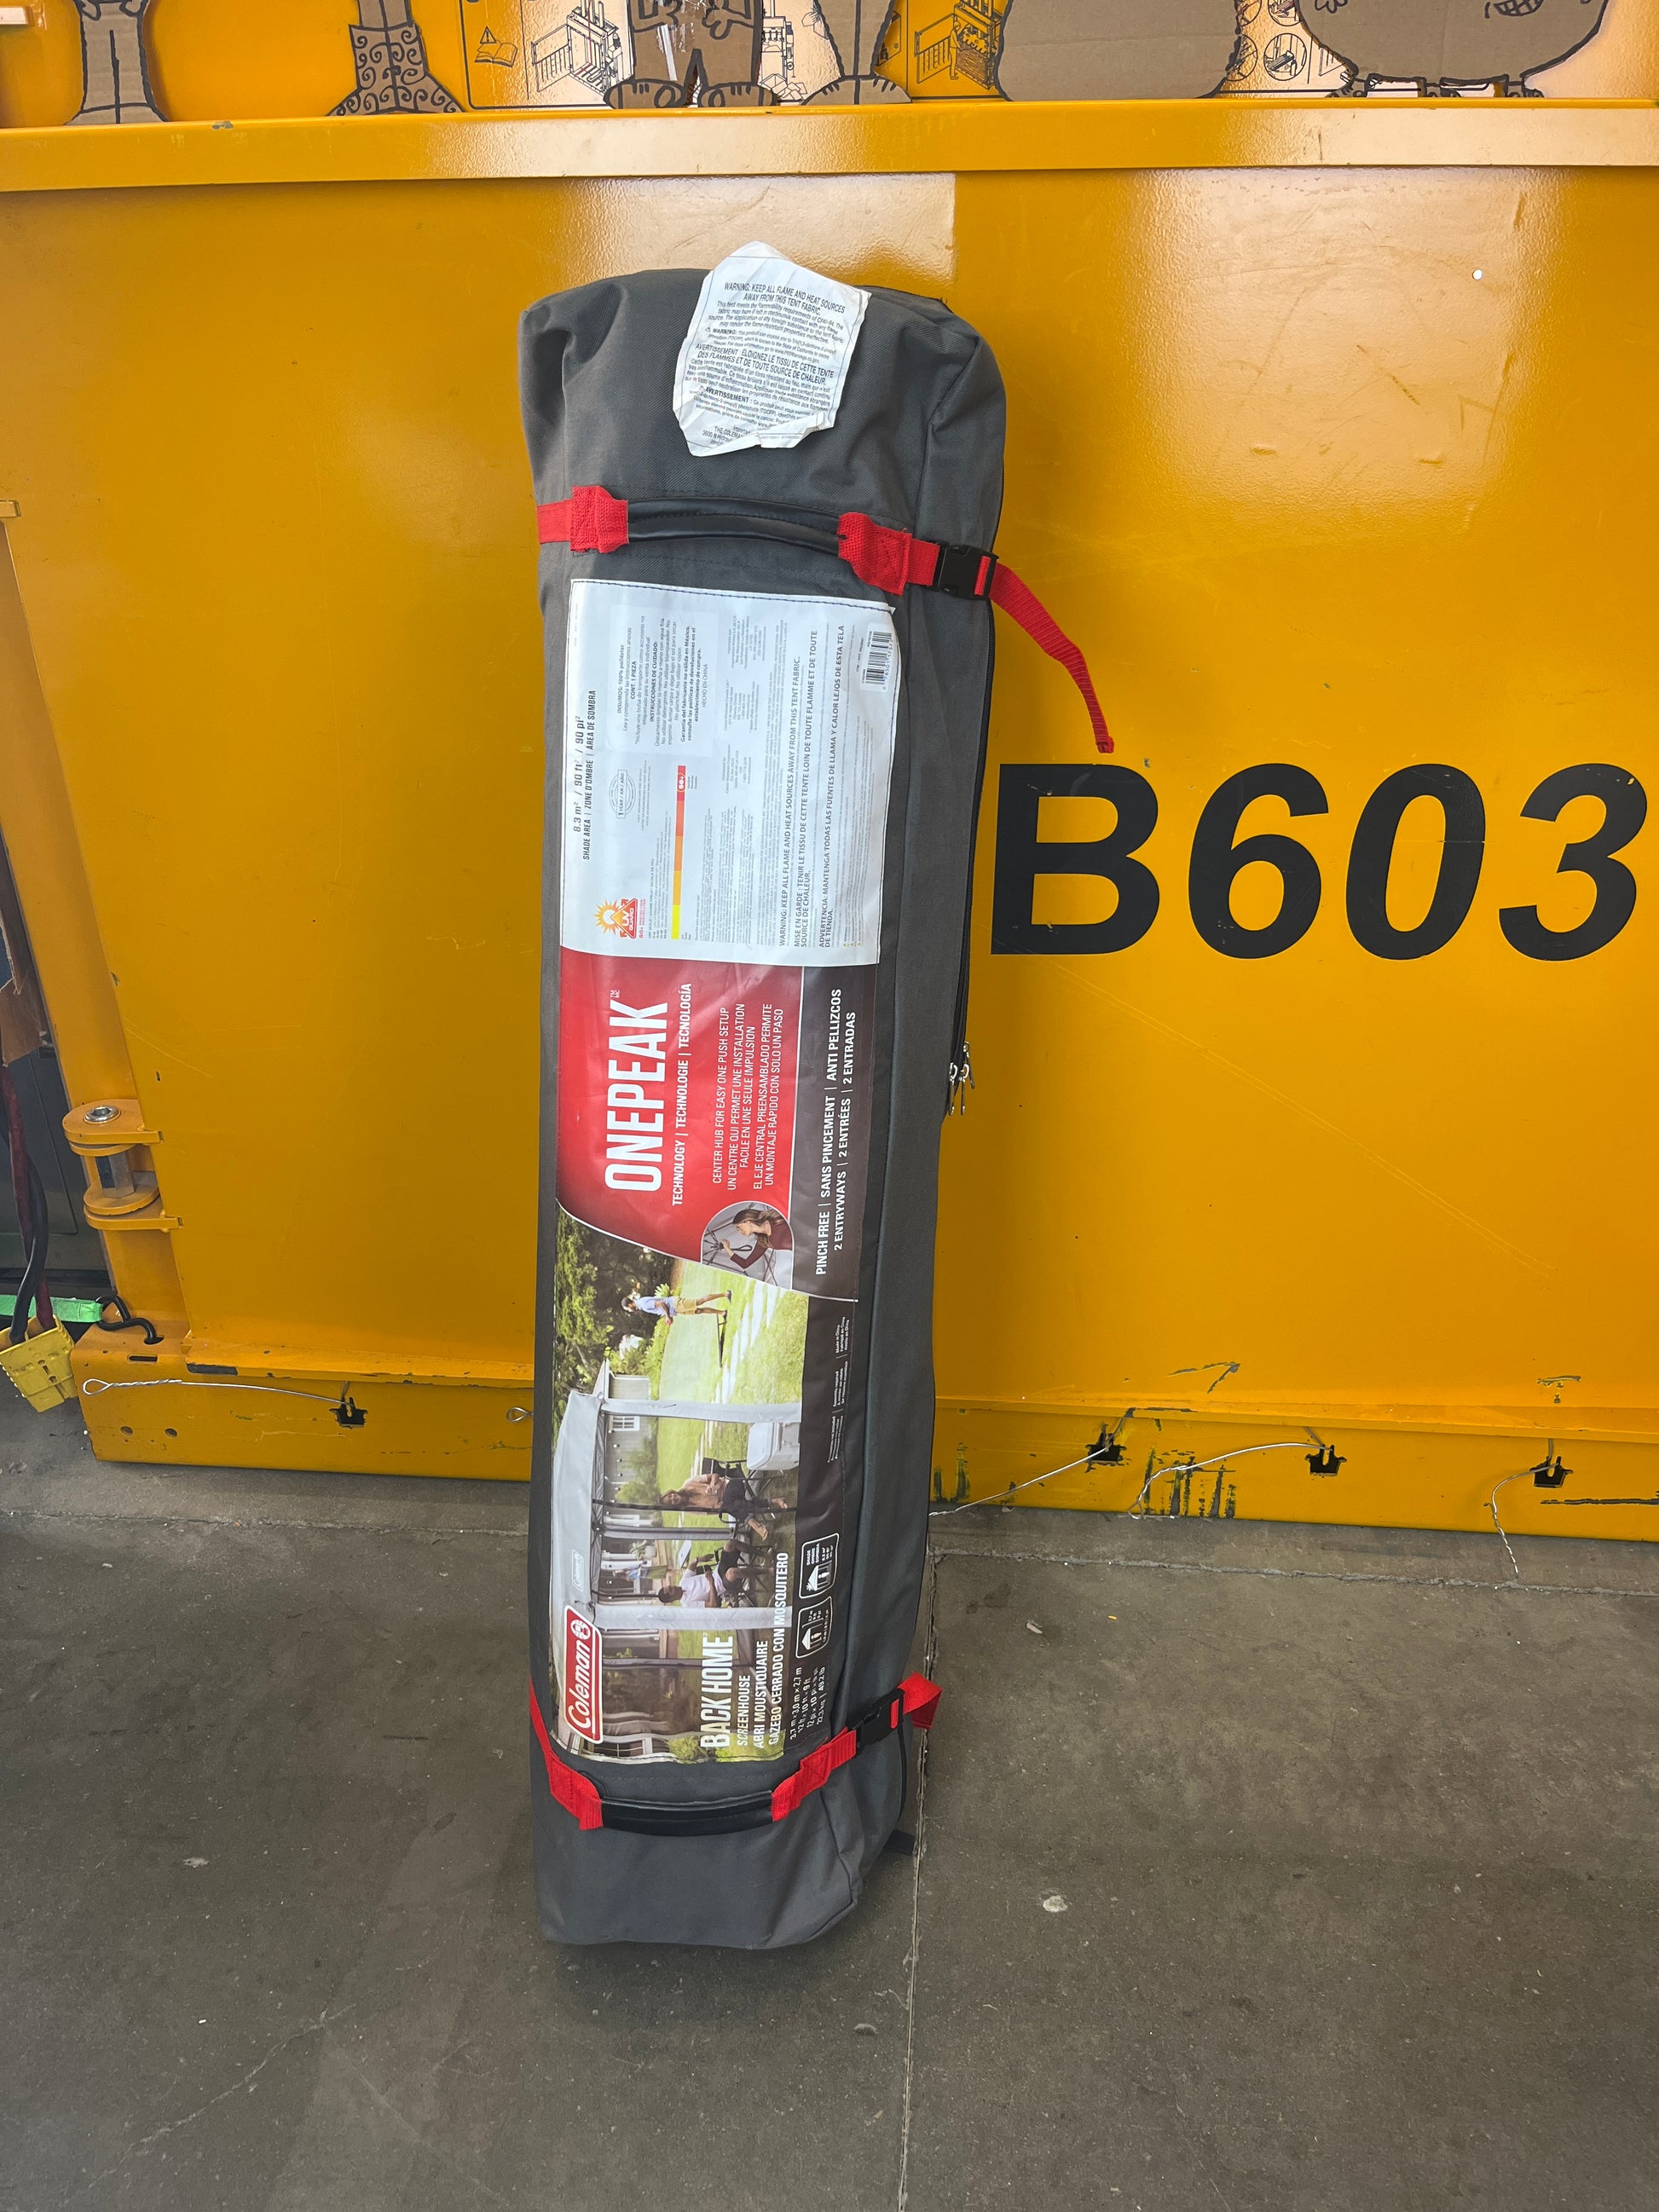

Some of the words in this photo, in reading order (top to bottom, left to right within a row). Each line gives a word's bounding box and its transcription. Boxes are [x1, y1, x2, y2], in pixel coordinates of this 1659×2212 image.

[725, 282, 751, 292] WARNING:
[751, 284, 766, 293] KEEP
[766, 285, 776, 293] ALL
[776, 286, 795, 296] FLAME
[794, 289, 807, 300] AND
[806, 293, 822, 304] HEAT
[820, 297, 847, 314] SOURCES
[759, 293, 775, 303] FROM
[774, 295, 787, 304] THIS
[787, 297, 802, 309] TENT
[801, 302, 823, 316] FABRIC.
[694, 343, 739, 356] AVERTISSEMENT
[767, 355, 776, 364] LE
[775, 356, 791, 367] TISSU
[790, 361, 800, 370] DE
[799, 362, 817, 374] CETTE
[816, 367, 835, 378] TENTE
[697, 351, 708, 360] DES
[708, 352, 736, 363] FLAMMES
[735, 356, 743, 365] ET
[743, 358, 752, 367] DE
[751, 360, 770, 371] TOUTE
[769, 363, 793, 378] SOURCE
[791, 370, 801, 379] DE
[703, 386, 749, 404] AVERTISSEMENT
[809, 631, 818, 656] TOUTE
[808, 658, 816, 668] DE
[808, 669, 815, 679] ET
[835, 667, 841, 678] DE
[587, 690, 596, 720] SOMBRA
[806, 680, 814, 714] FLAMME
[575, 731, 584, 744] 90
[587, 721, 595, 731] DE
[785, 774, 794, 809] SOURCES
[792, 656, 801, 686] FABRIC.
[804, 742, 811, 753] DE
[574, 774, 583, 787] 90
[585, 759, 593, 791] D'OMBRE
[828, 765, 835, 775] DE
[826, 776, 835, 809] FUENTES
[800, 822, 806, 833] DE
[582, 838, 591, 860] SHADE
[798, 834, 806, 855] TISSU
[798, 856, 805, 864] LE
[822, 852, 830, 895] MANTENGA
[991, 763, 1648, 961] B603
[796, 865, 805, 887] TENIR
[802, 870, 811, 906] CHALEUR.
[622, 910, 629, 926] UV
[795, 918, 801, 928] EN
[802, 907, 809, 917] DE
[818, 896, 830, 948] ADVERTENCIA:
[825, 908, 834, 937] TIENDA.
[824, 938, 830, 948] DE
[676, 983, 691, 1049] TECNOLOGÍA
[716, 1008, 730, 1037] SETUP
[760, 1003, 772, 1042] PERMITE
[772, 1008, 783, 1033] PASO
[829, 989, 841, 1051] PELLIZCOS
[733, 1003, 745, 1067] INSTALLATION
[772, 1035, 782, 1048] UN
[843, 1012, 856, 1076] ENTRADAS
[718, 1038, 728, 1063] PUSH
[743, 1026, 755, 1076] IMPULSION
[771, 1050, 781, 1073] SOLO
[717, 1065, 727, 1083] ONE
[731, 1069, 742, 1088] UNE
[826, 1053, 838, 1081] ANTI
[605, 999, 668, 1192] ONEPEAK
[675, 1060, 688, 1129] TECHNOLOGIE
[715, 1085, 726, 1108] EASY
[743, 1077, 754, 1105] SEULE
[757, 1044, 770, 1123] PREENSAMBLADO
[769, 1075, 780, 1094] CON
[714, 1110, 725, 1128] FOR
[730, 1089, 741, 1124] PERMET
[742, 1106, 752, 1124] UNE
[766, 1095, 779, 1128] RÁPIDO
[729, 1126, 739, 1142] QUI
[741, 1126, 751, 1139] EN
[822, 1095, 835, 1164] PINCEMENT
[837, 1098, 851, 1149] ENTRÉES
[714, 1129, 724, 1148] HUB
[754, 1123, 766, 1162] CENTRAL
[766, 1129, 777, 1171] MONTAJE
[713, 1150, 723, 1184] CENTER
[728, 1143, 738, 1176] CENTRE
[739, 1140, 750, 1168] FACILE
[672, 1140, 685, 1206] TECHNOLOGY
[727, 1177, 737, 1190] UN
[753, 1179, 762, 1189] EL
[754, 1164, 764, 1178] EJE
[765, 1172, 774, 1186] UN
[820, 1165, 832, 1198] SANS
[834, 1171, 847, 1242] ENTRYWAYS
[818, 1210, 830, 1239] FREE
[815, 1239, 829, 1275] PINCH
[834, 1243, 842, 1251] 2
[774, 1553, 788, 1625] MOSQUITERO
[772, 1628, 784, 1652] CON
[701, 1637, 733, 1693] HOME
[569, 1640, 591, 1729] Coleman
[754, 1640, 767, 1722] MOUSTIQUAIRE
[771, 1654, 783, 1705] CERRADO
[701, 1696, 731, 1747] BACK
[737, 1675, 750, 1746] SCREENHOUSE
[754, 1724, 766, 1748] ABRI
[769, 1707, 781, 1745] GAZEBO
